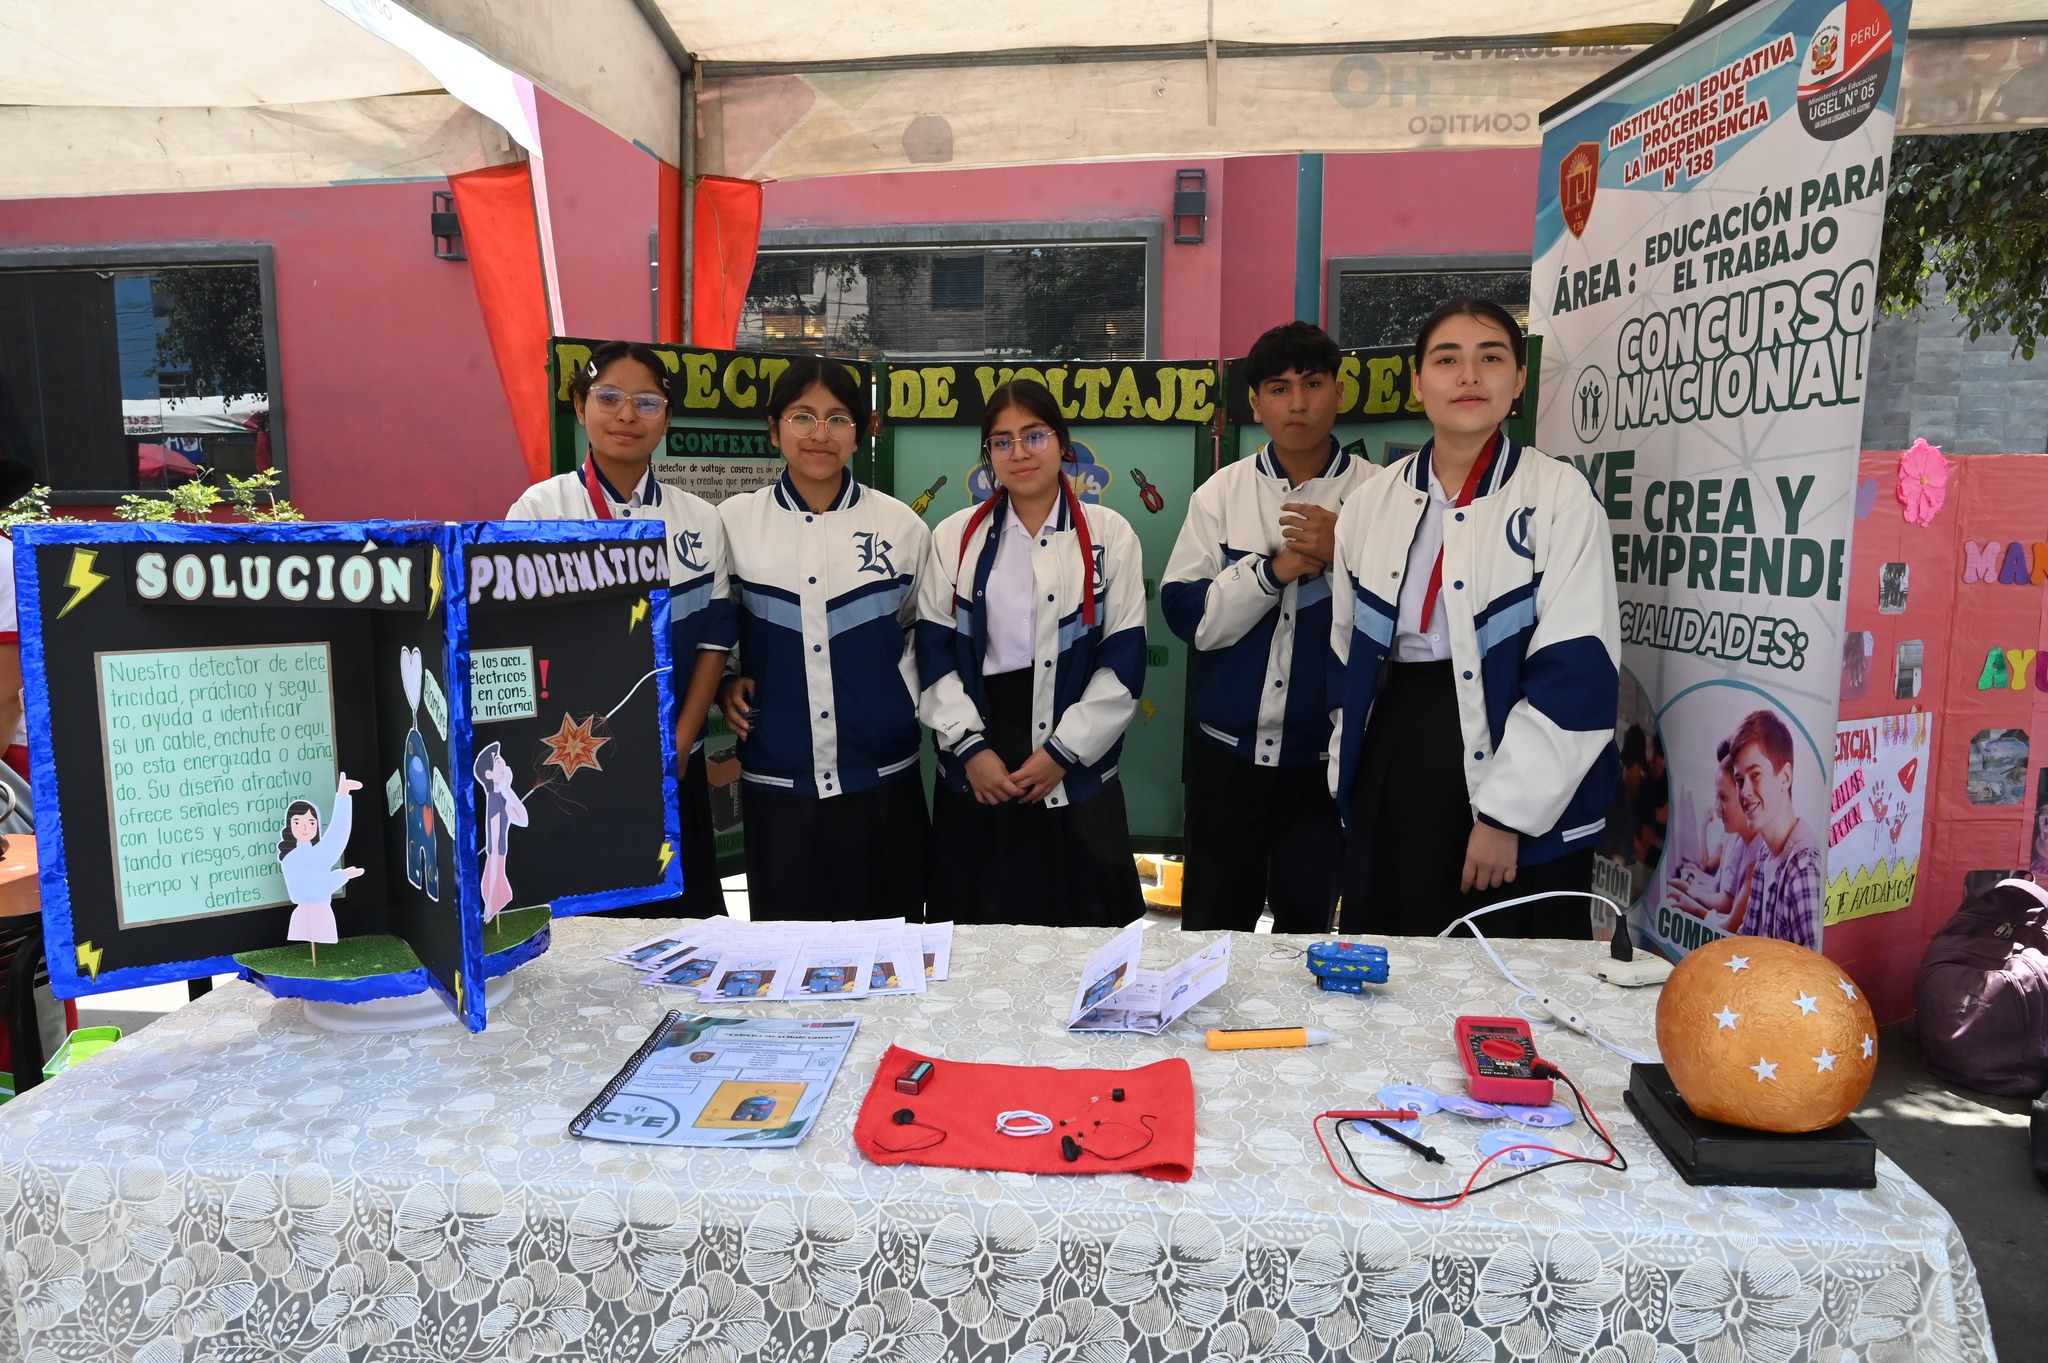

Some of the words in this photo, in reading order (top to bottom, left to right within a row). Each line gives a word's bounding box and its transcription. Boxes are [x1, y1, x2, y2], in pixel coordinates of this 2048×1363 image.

[1850, 18, 1880, 47] PERÚ
[1609, 85, 1695, 148] INSTITUCIÓN
[1699, 36, 1795, 101] EDUCATIVA
[1809, 97, 1841, 120] UGEL
[1861, 82, 1875, 101] 05
[1839, 87, 1847, 95] de
[1642, 101, 1719, 154] PRÓCERES
[1722, 87, 1744, 119] DE
[1625, 160, 1641, 184] LA
[1644, 101, 1769, 174] INDEPENDENCIA
[1685, 149, 1713, 178] 138
[1572, 221, 1584, 233] 138
[1645, 187, 1792, 268] EDUCACIÓN
[1799, 156, 1884, 218] PARA
[1673, 260, 1697, 294] EL
[1703, 217, 1839, 286] TRABAJO
[1552, 259, 1620, 316] ÁREA
[1617, 259, 1875, 374] CONCURSO
[887, 366, 958, 419] DE
[975, 366, 1215, 422] VLTAJE
[1614, 334, 1864, 431] NACIONAL
[658, 463, 686, 473] detector
[689, 463, 698, 473] de
[701, 463, 726, 476] voltaje
[730, 466, 754, 475] casero
[1554, 450, 1635, 520] YE
[1643, 477, 1757, 535] CREA
[1776, 474, 1816, 536] Y
[136, 539, 413, 604] SOLUCIÓN
[469, 543, 671, 604] PROBLEMÁTICA
[1619, 600, 1809, 672] CIALIDADES:
[109, 658, 180, 683] Nuestro
[189, 655, 262, 678] detector
[269, 653, 288, 673] de
[482, 655, 499, 669] los
[110, 684, 185, 708] tricidad,
[189, 680, 257, 709] práctico
[264, 681, 273, 699] y
[478, 689, 493, 702] en
[485, 700, 535, 717] informal
[112, 714, 136, 731] ro,
[141, 707, 193, 732] ayuda
[202, 708, 213, 723] a
[220, 700, 303, 722] identificar
[112, 738, 127, 755] si
[135, 736, 155, 754] un
[162, 731, 211, 752] cable,
[214, 722, 276, 747] enchufe
[280, 725, 290, 739] o
[114, 762, 134, 779] po
[143, 757, 176, 775] esta
[183, 747, 272, 775] energizada
[279, 748, 289, 762] o
[116, 783, 141, 801] do.
[148, 779, 170, 799] Su
[179, 776, 234, 798] diseño
[242, 769, 312, 792] atractivo
[119, 807, 173, 826] ofrece
[180, 800, 240, 820] señales
[120, 832, 147, 848] con
[158, 825, 204, 845] luces
[213, 826, 221, 842] y
[122, 849, 172, 873] tando
[181, 848, 245, 867] riesgos,
[248, 841, 278, 858] aho
[125, 877, 182, 898] tiempo
[190, 874, 199, 890] y
[209, 861, 284, 889] previnien
[204, 886, 264, 909] dentes.
[596, 1111, 668, 1128] CYE
